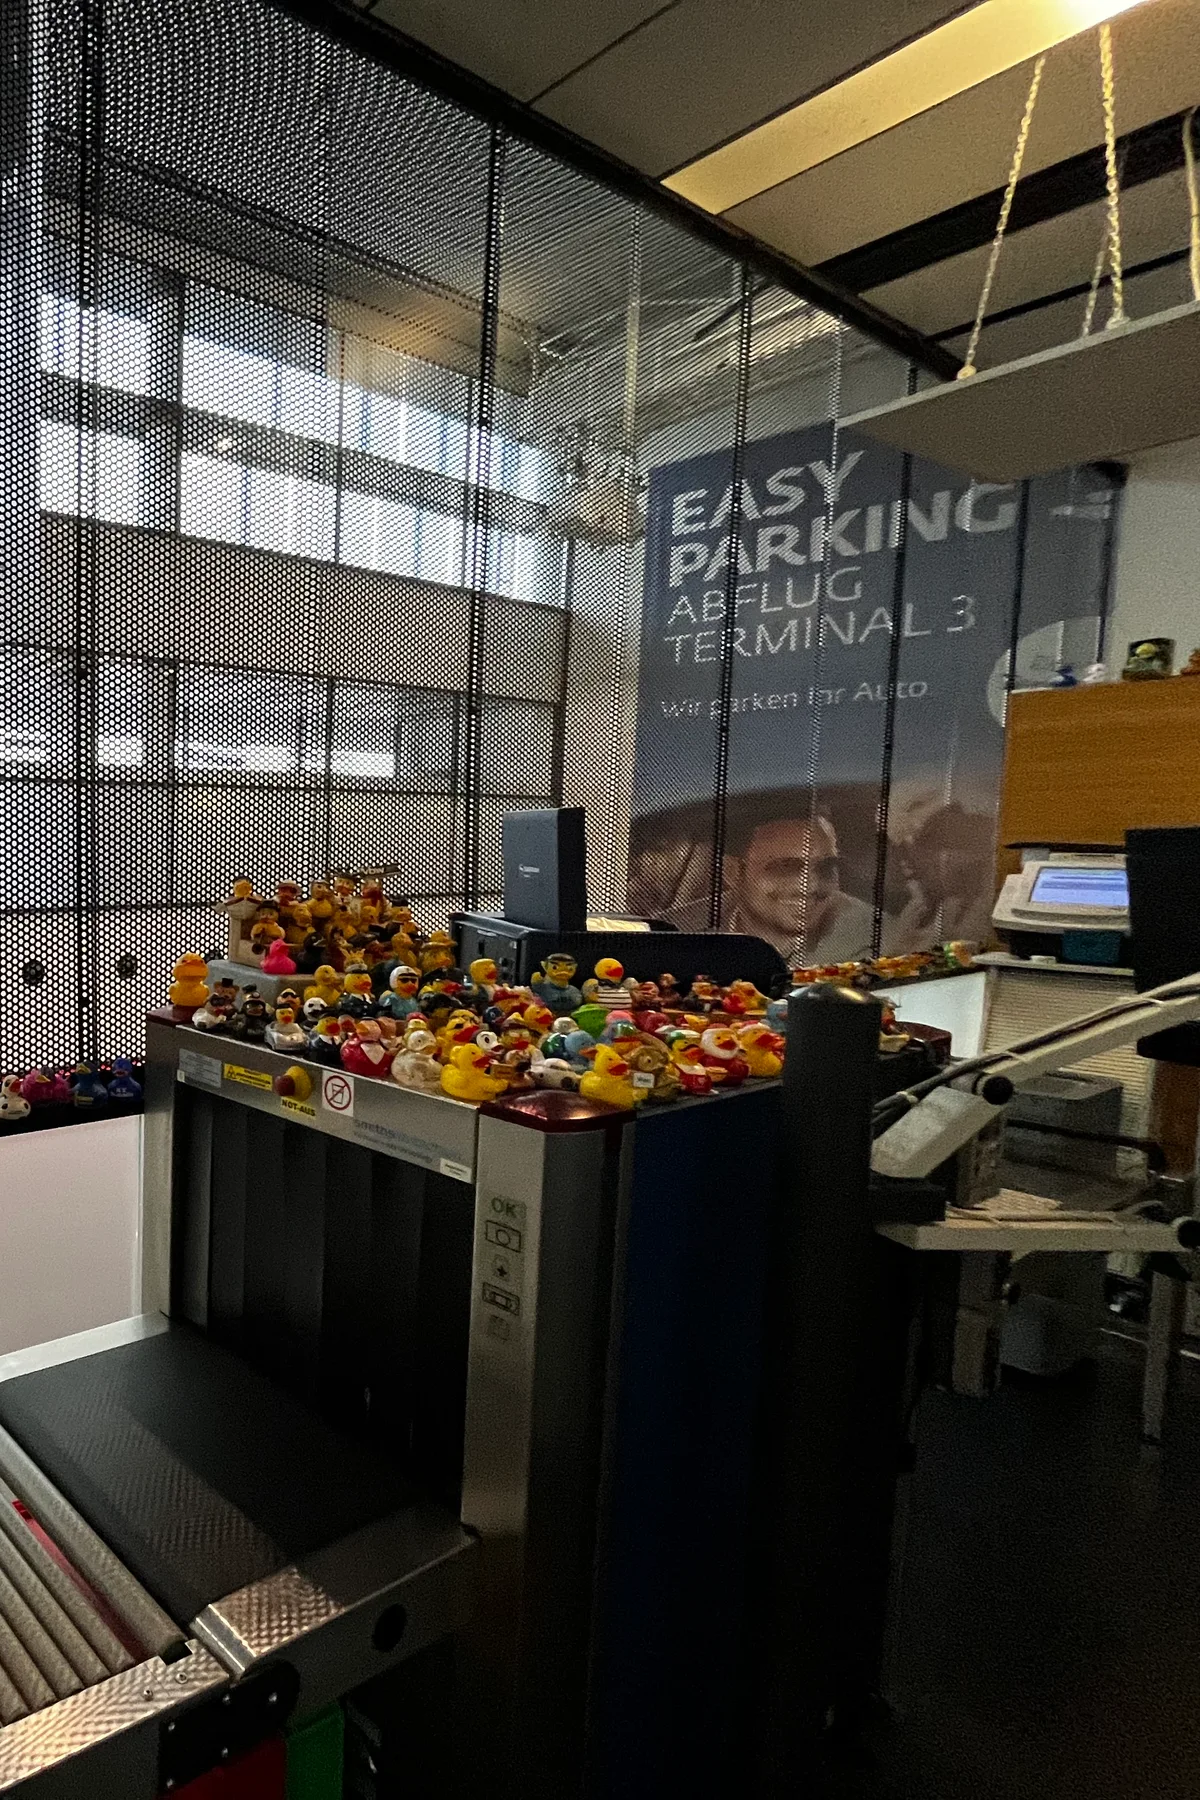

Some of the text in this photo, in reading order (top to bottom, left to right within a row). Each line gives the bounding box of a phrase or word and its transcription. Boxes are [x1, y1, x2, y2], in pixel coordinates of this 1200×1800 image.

[672, 450, 865, 537] EASY
[669, 481, 1017, 588] PARKING
[664, 595, 975, 664] TERMINAL 3
[667, 566, 862, 624] ABFLUG
[491, 1197, 517, 1218] OK
